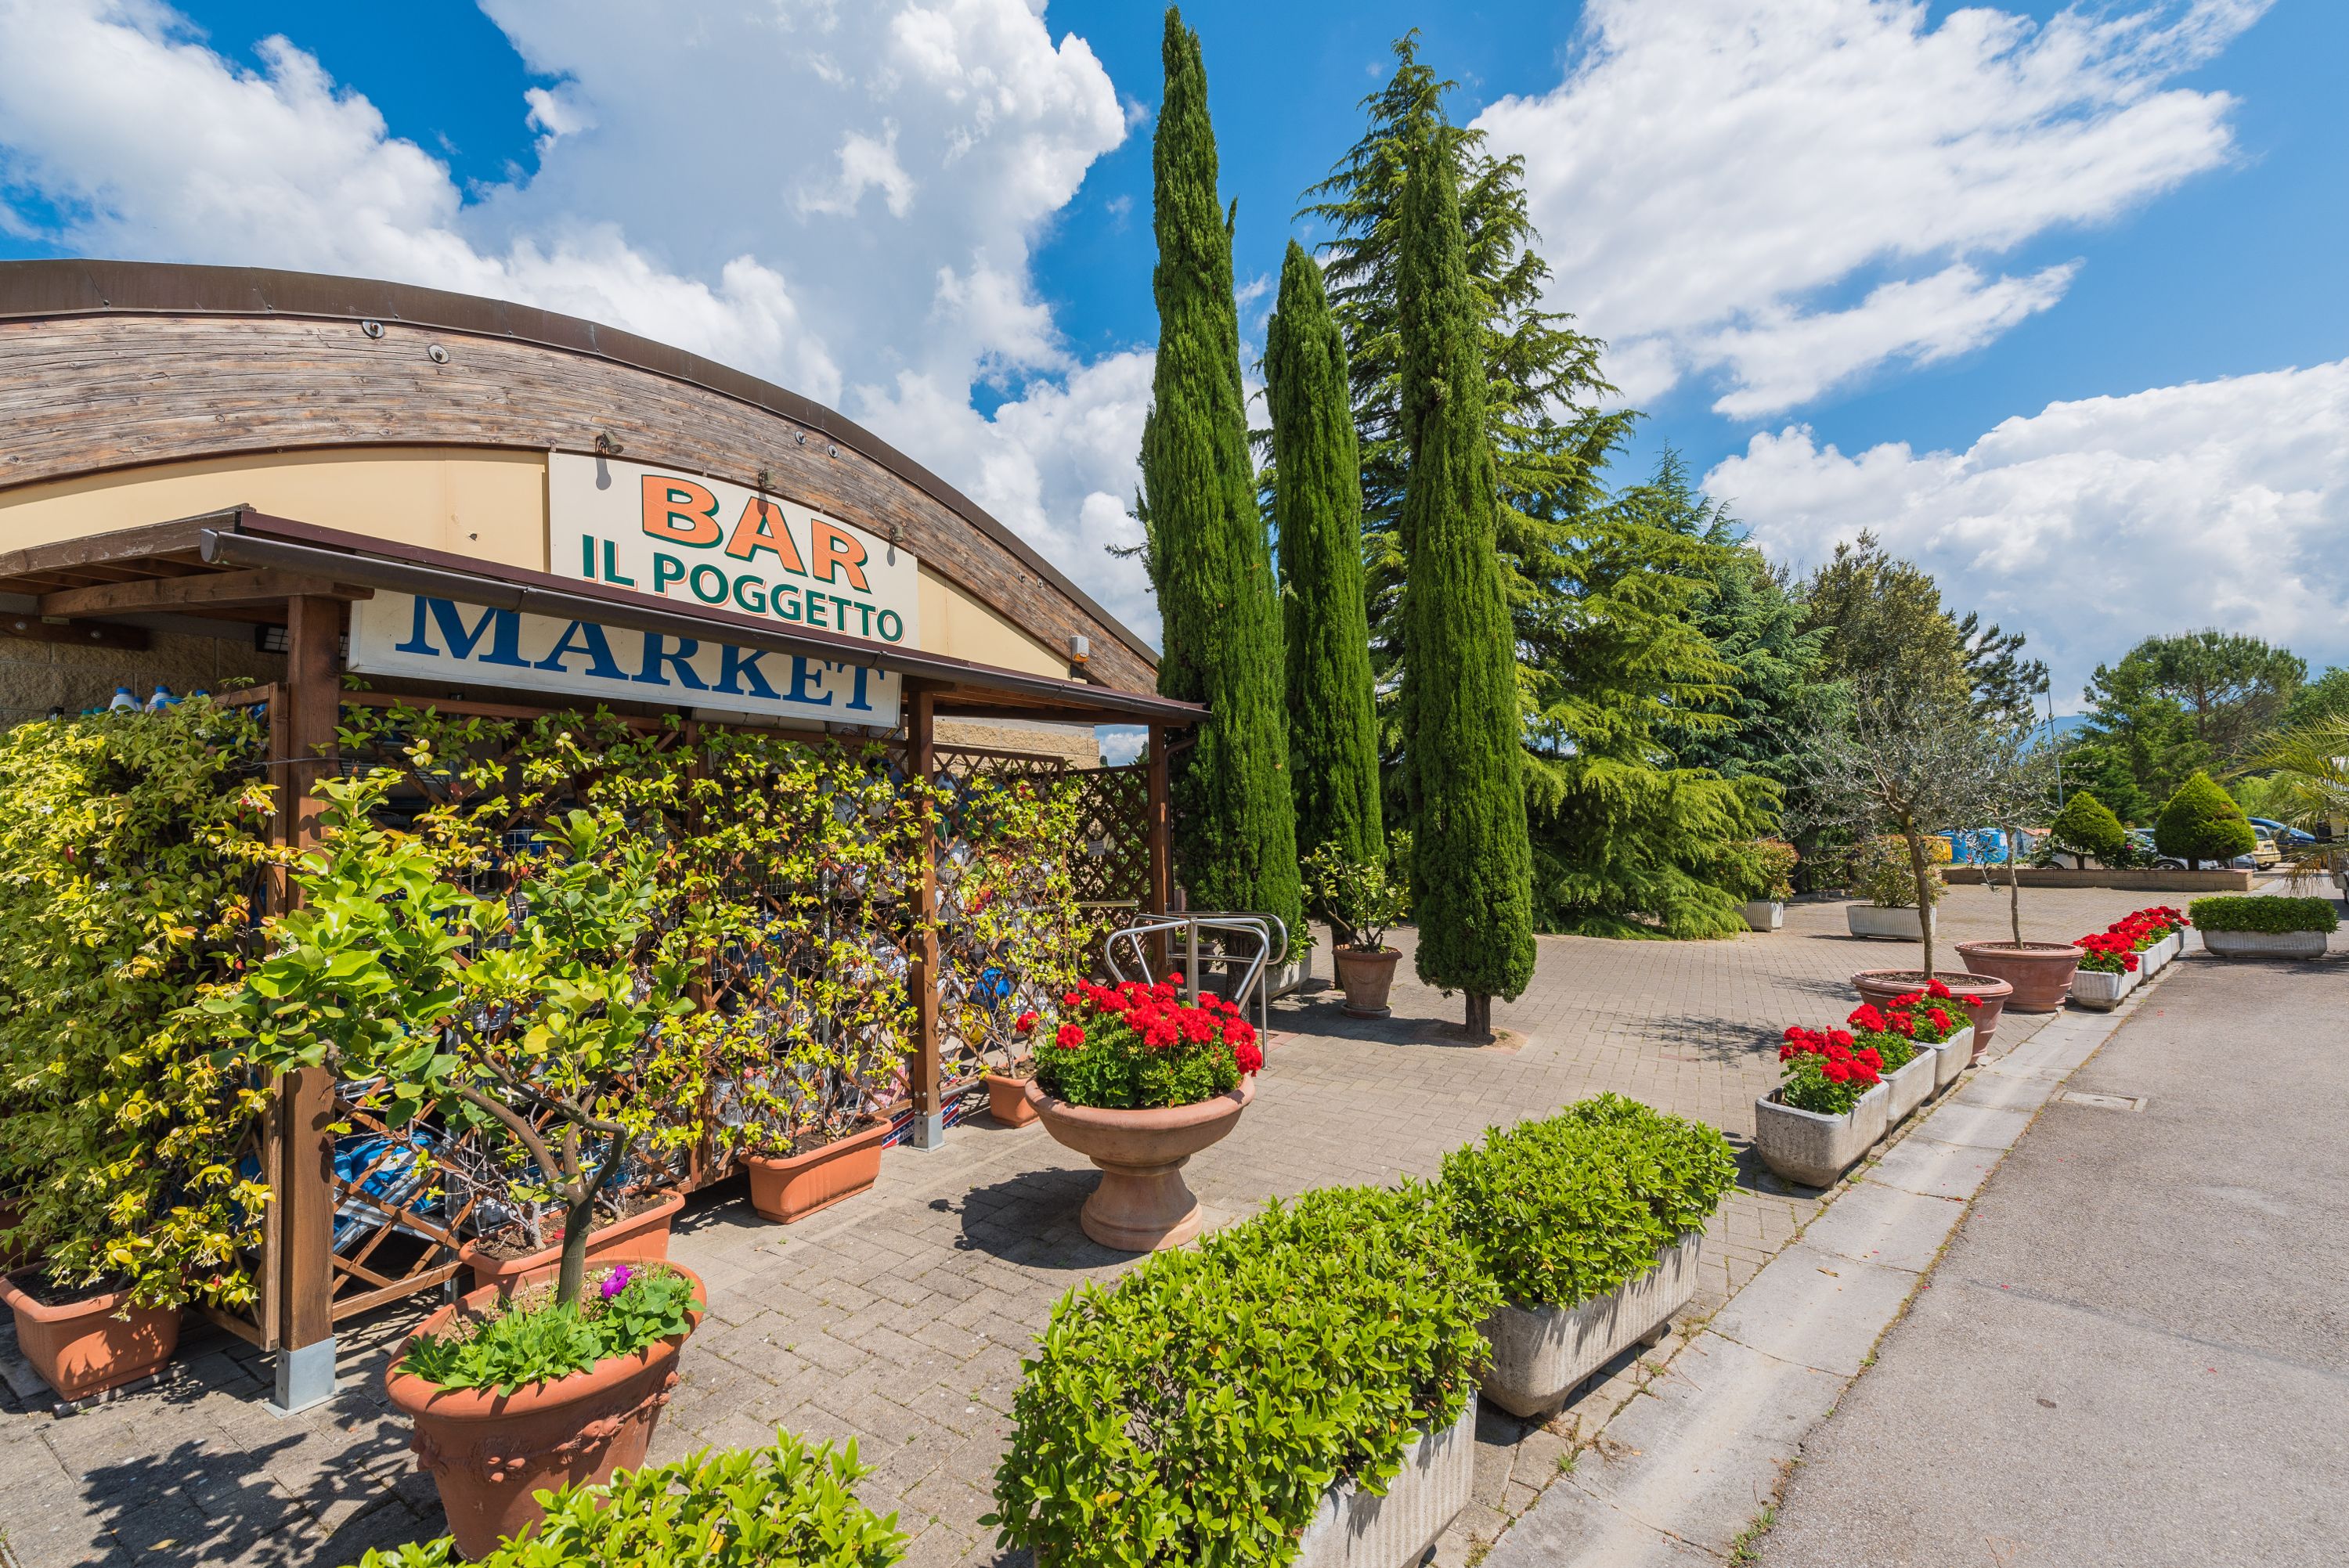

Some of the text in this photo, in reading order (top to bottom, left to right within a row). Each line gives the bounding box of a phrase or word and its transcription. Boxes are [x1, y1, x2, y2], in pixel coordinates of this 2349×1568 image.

[582, 534, 905, 644] IL POGGETTO
[640, 474, 871, 594] BAR
[395, 597, 885, 712] MARKET
